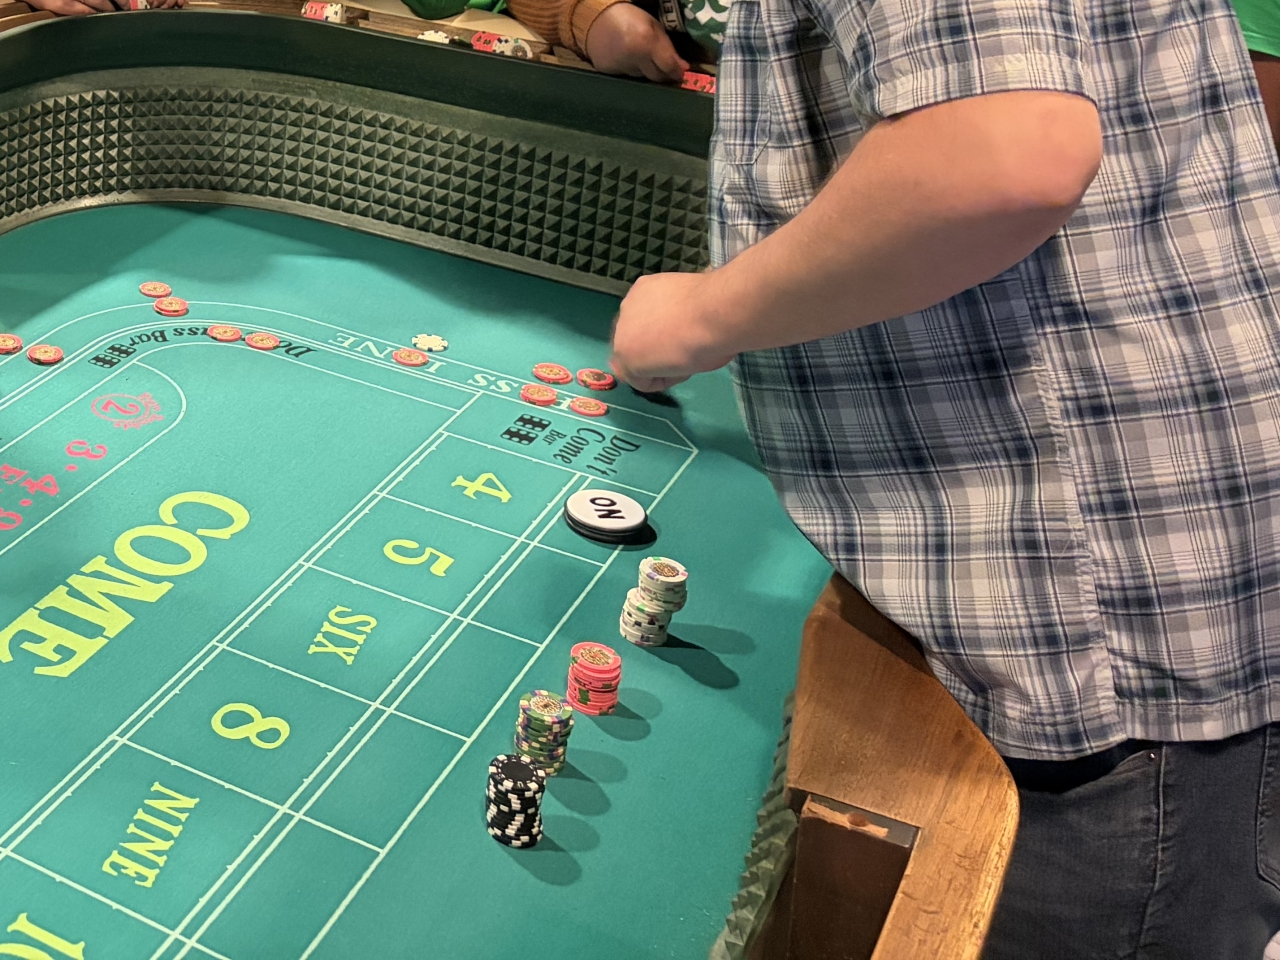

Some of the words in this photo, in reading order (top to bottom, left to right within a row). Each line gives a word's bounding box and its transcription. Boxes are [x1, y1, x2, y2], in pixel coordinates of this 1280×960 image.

[127, 328, 169, 348] Bar
[101, 399, 140, 415] 2
[539, 424, 568, 446] Bar
[553, 427, 606, 465] Come
[594, 433, 641, 476] Don't
[451, 472, 513, 504] 4
[587, 495, 626, 522] ON
[382, 538, 456, 578] 5
[308, 605, 379, 665] SIX
[210, 701, 292, 750] 8
[101, 782, 201, 888] NINE
